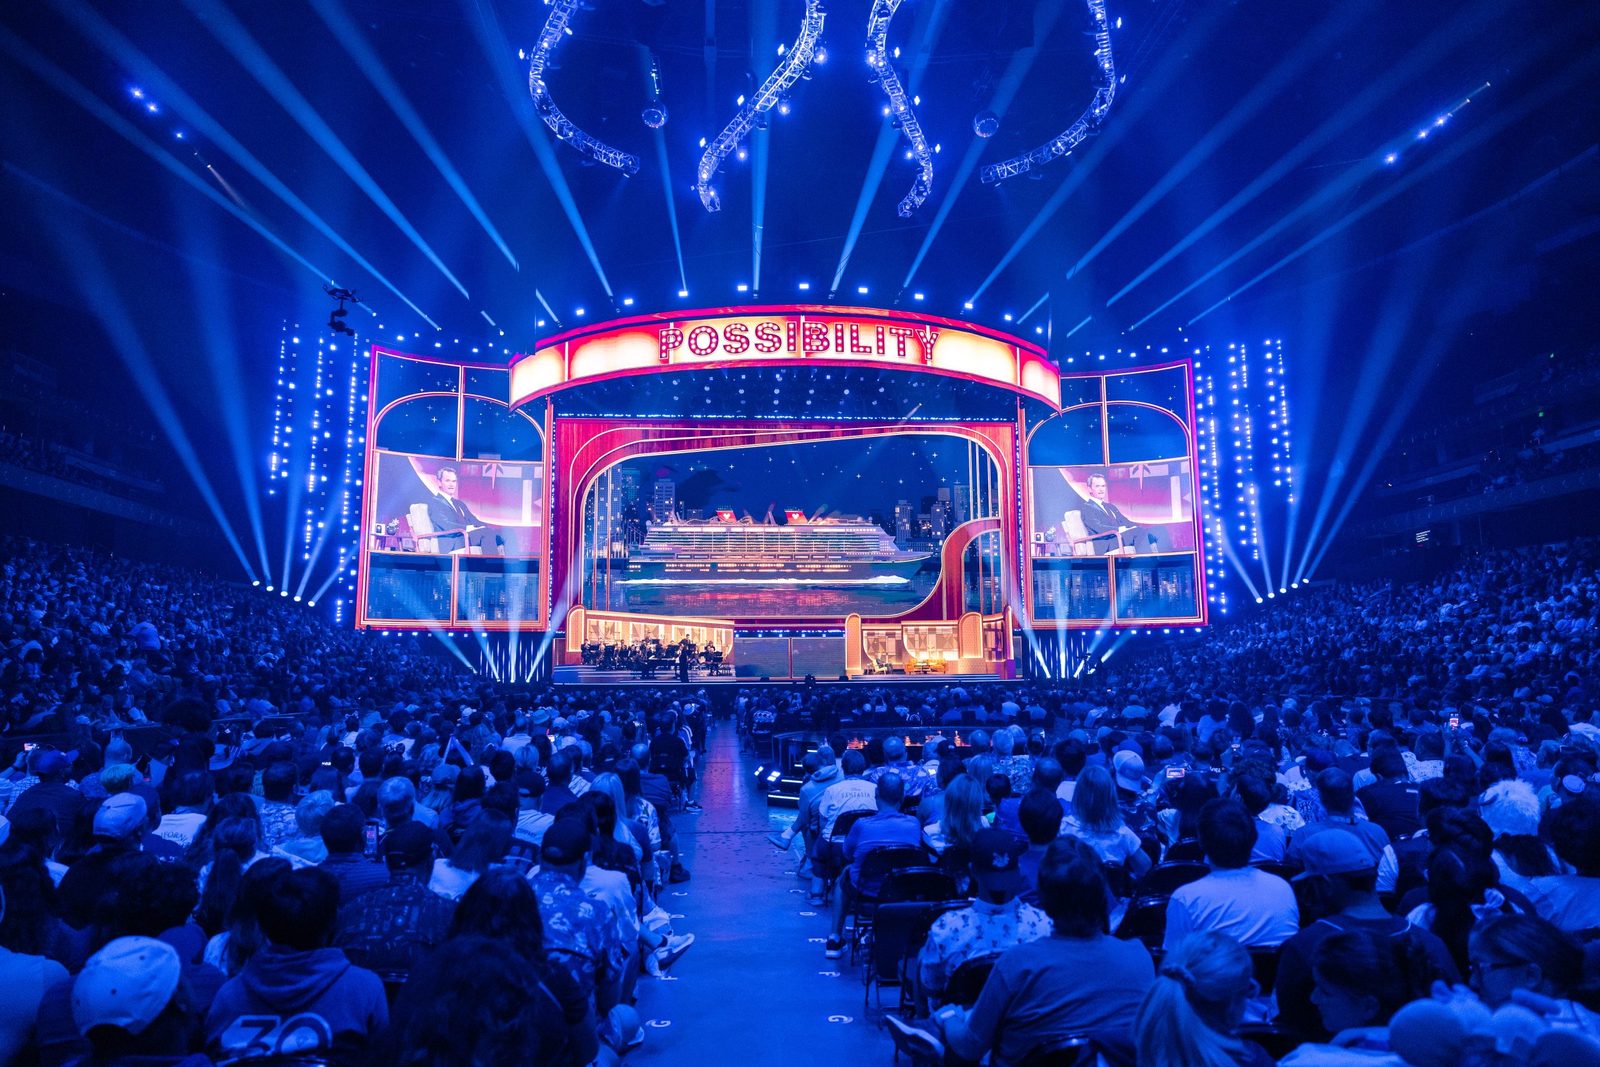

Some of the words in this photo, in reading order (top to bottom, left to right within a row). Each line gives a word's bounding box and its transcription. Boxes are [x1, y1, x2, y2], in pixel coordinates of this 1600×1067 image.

[659, 321, 940, 361] POSSIBILITY
[827, 1014, 854, 1023] G
[645, 1019, 672, 1028] G
